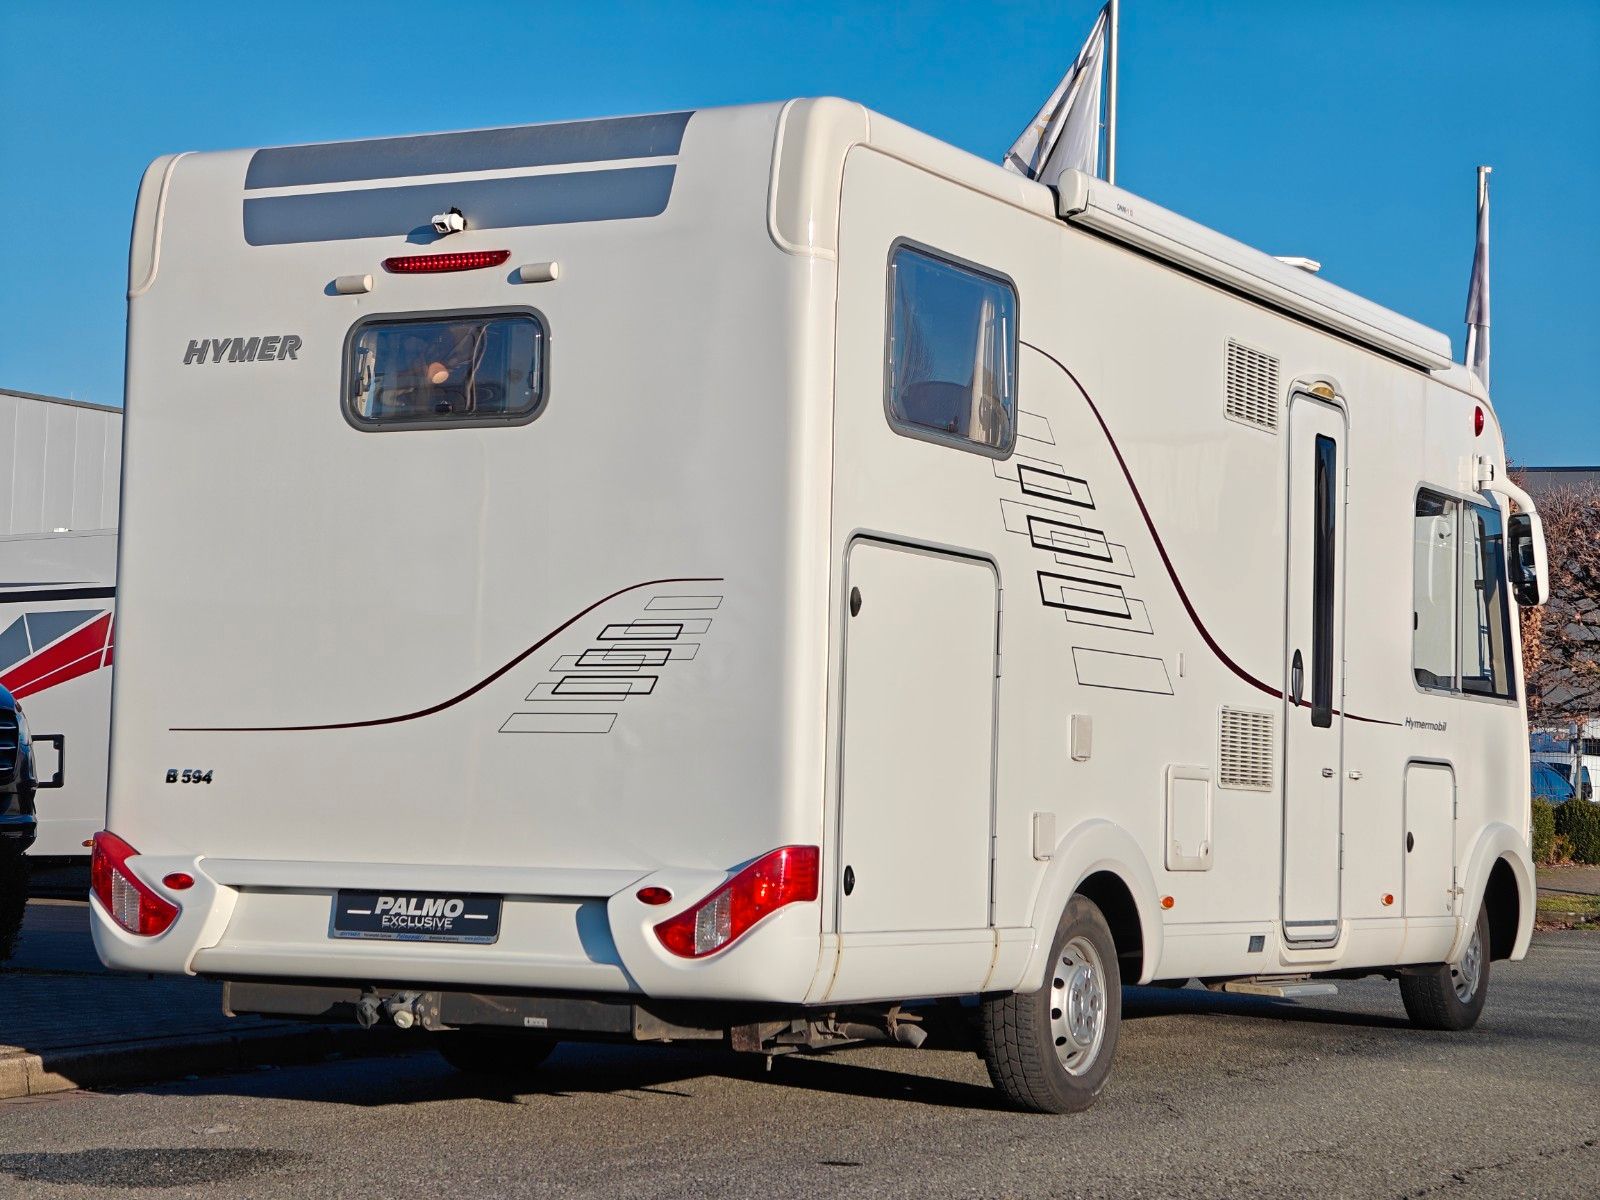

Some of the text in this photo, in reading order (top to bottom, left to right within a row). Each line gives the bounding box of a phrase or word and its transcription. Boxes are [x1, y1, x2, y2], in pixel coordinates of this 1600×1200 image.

[182, 335, 302, 364] HYMER
[1404, 716, 1447, 731] Hymermobil
[165, 768, 213, 784] B 594
[374, 896, 465, 918] PALMO
[382, 915, 453, 928] EXCLUSIVE
